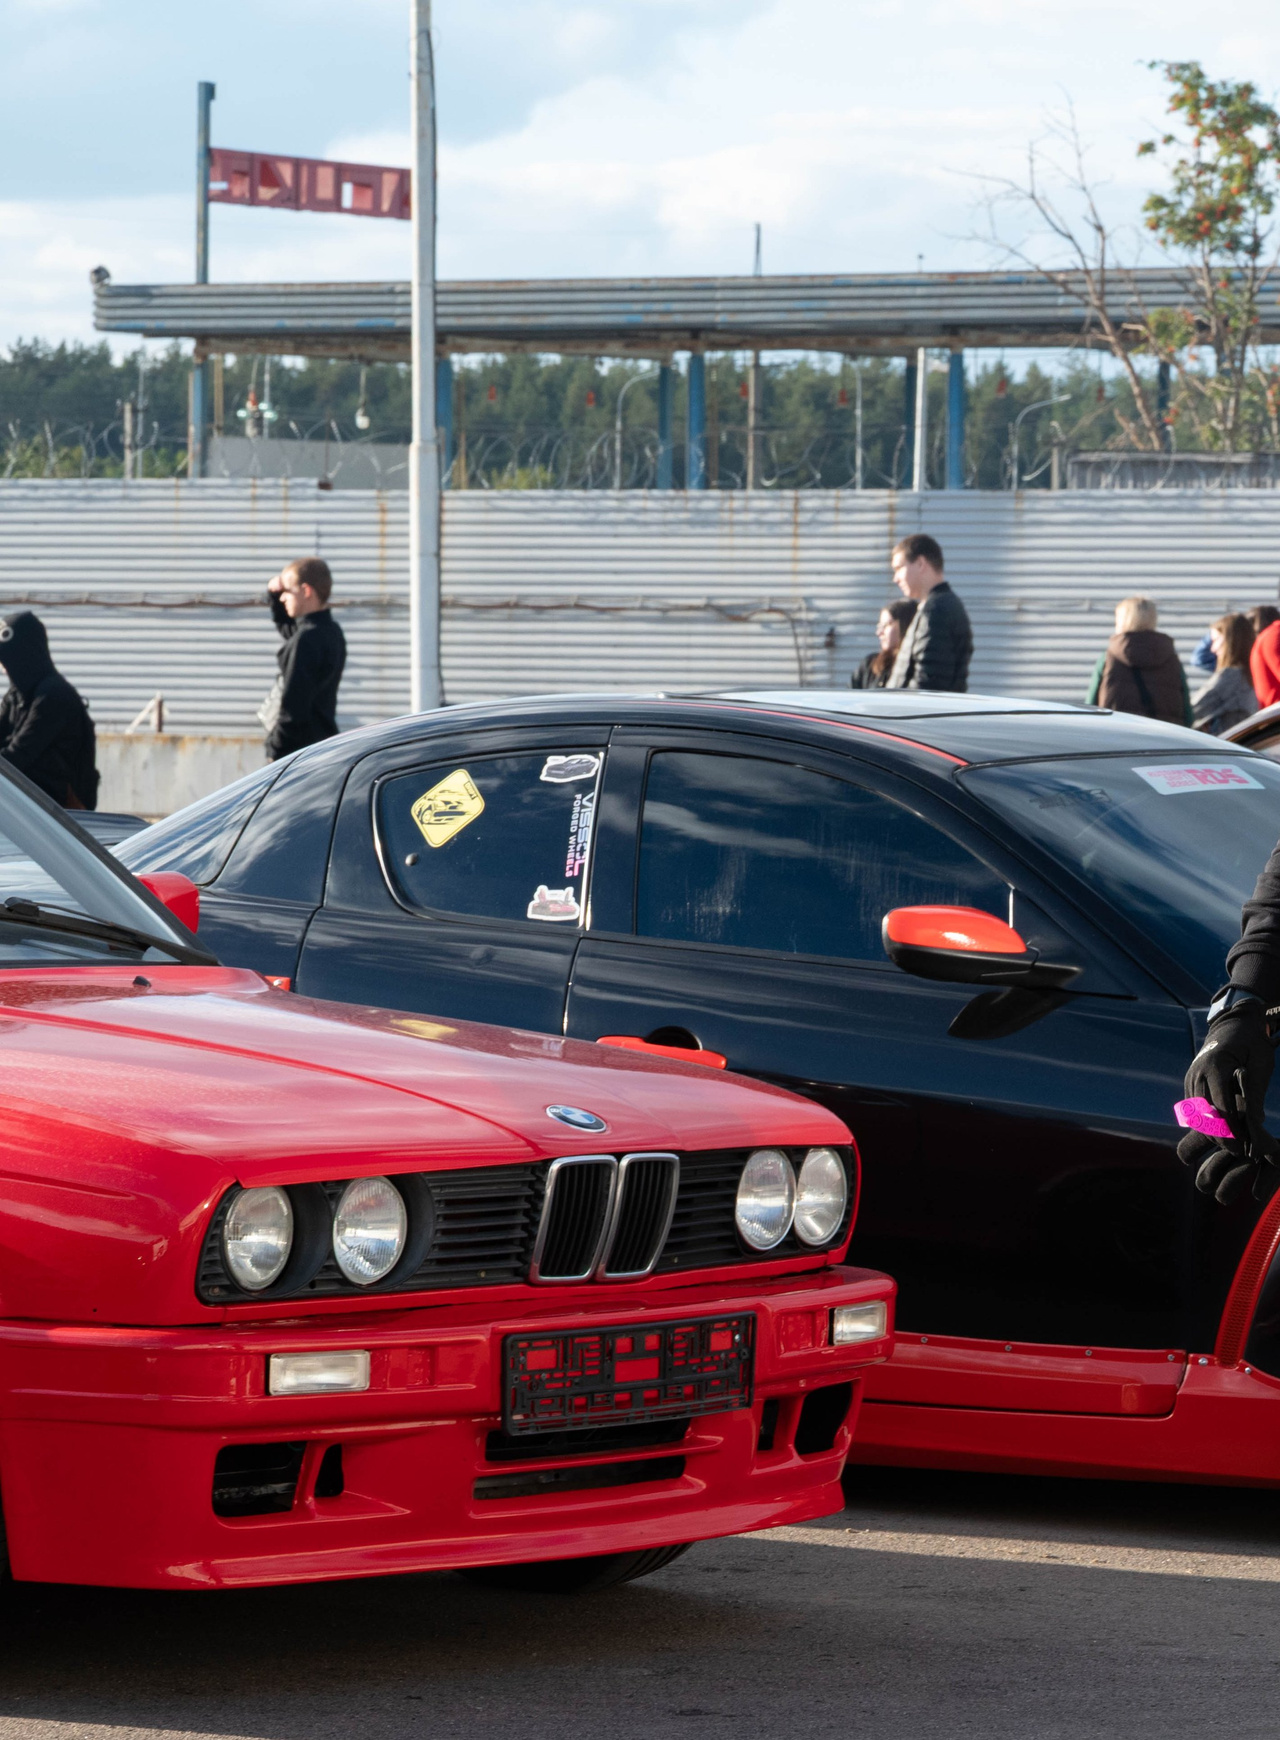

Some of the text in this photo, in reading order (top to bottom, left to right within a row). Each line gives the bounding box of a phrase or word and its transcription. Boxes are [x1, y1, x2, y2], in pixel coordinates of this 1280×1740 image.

[1184, 768, 1249, 784] RDS
[565, 793, 582, 877] FORGED WHEELS
